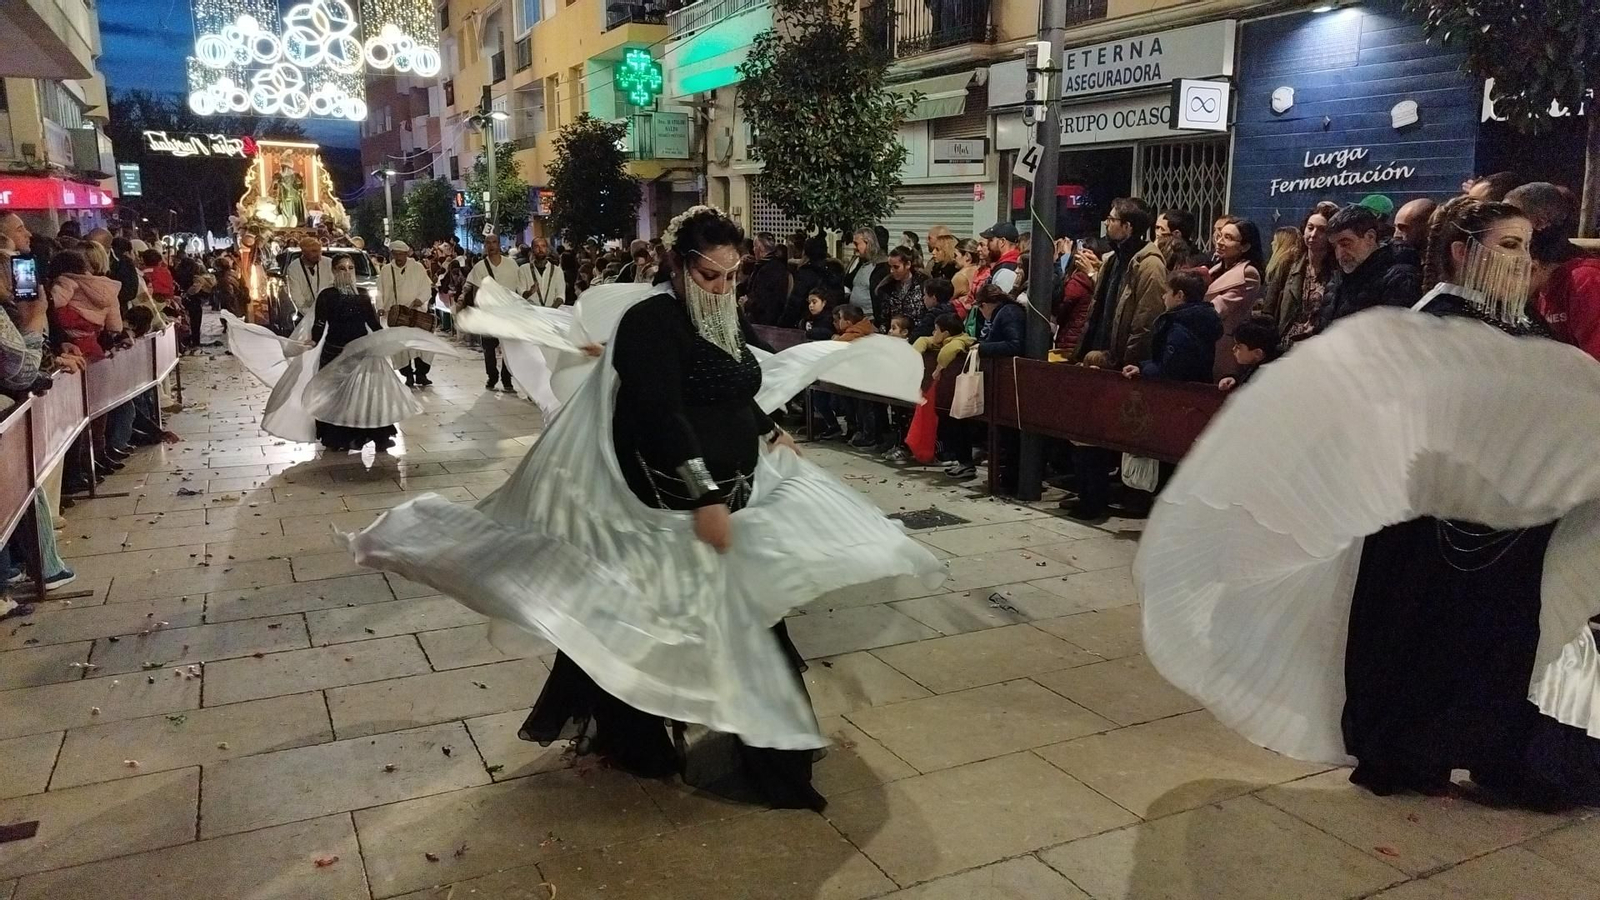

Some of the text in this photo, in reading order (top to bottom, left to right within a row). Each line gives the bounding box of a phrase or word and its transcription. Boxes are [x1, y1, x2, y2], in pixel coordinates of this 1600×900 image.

[1067, 37, 1163, 70] ETERNA
[1065, 63, 1162, 92] ASEGURADORA
[1022, 146, 1038, 173] 4
[1303, 147, 1369, 169] Larga
[1270, 161, 1416, 196] Fermentación
[484, 225, 492, 234] 3
